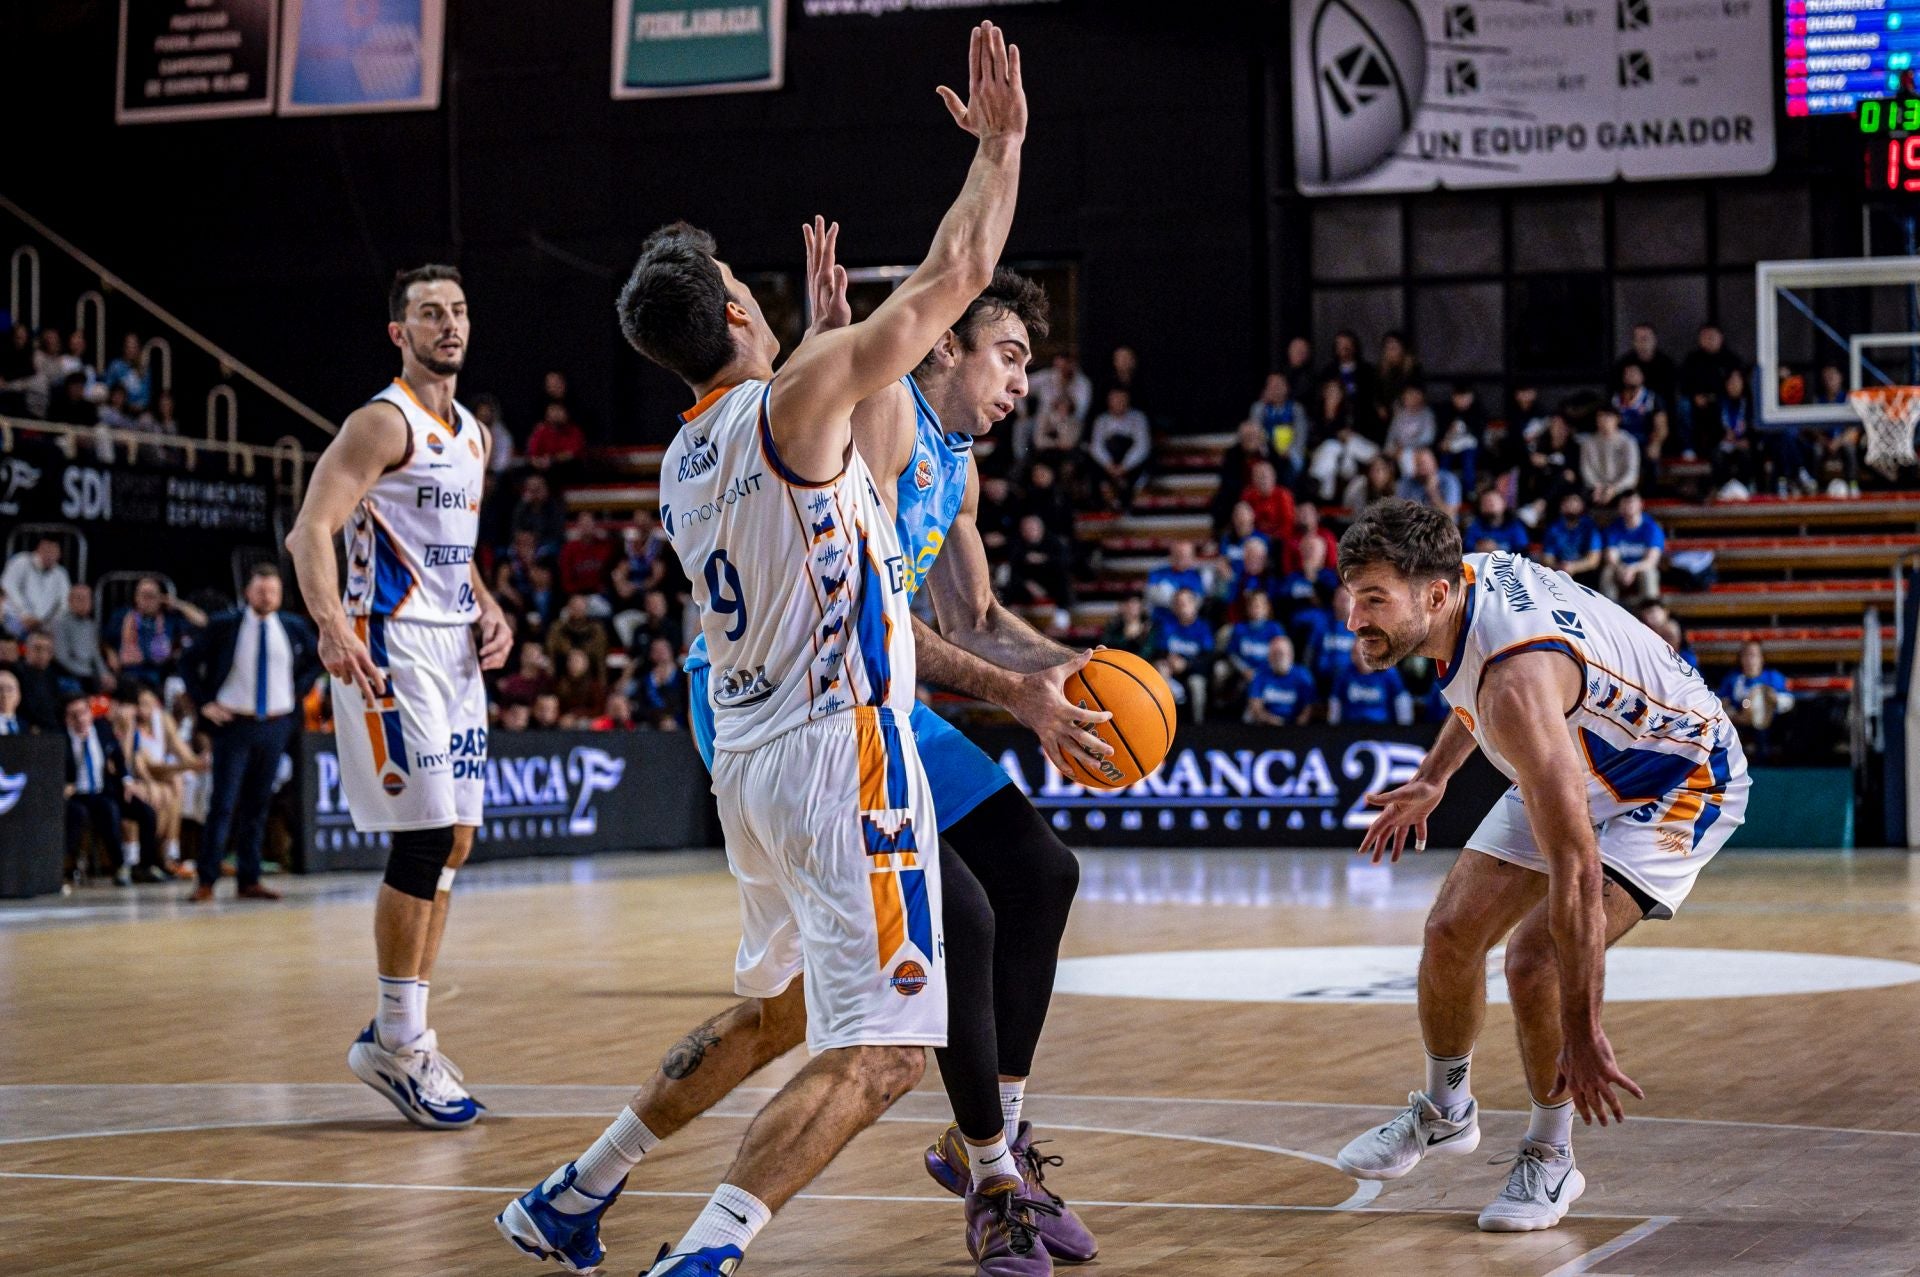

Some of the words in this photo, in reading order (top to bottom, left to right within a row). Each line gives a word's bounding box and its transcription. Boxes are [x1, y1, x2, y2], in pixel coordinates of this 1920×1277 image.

[1416, 127, 1462, 159] UN
[1471, 122, 1589, 154] EQUIPO
[1596, 115, 1755, 149] GANADOR
[61, 464, 112, 521] SDI
[703, 547, 747, 642] 9
[1051, 808, 1339, 831] COMERCIAL
